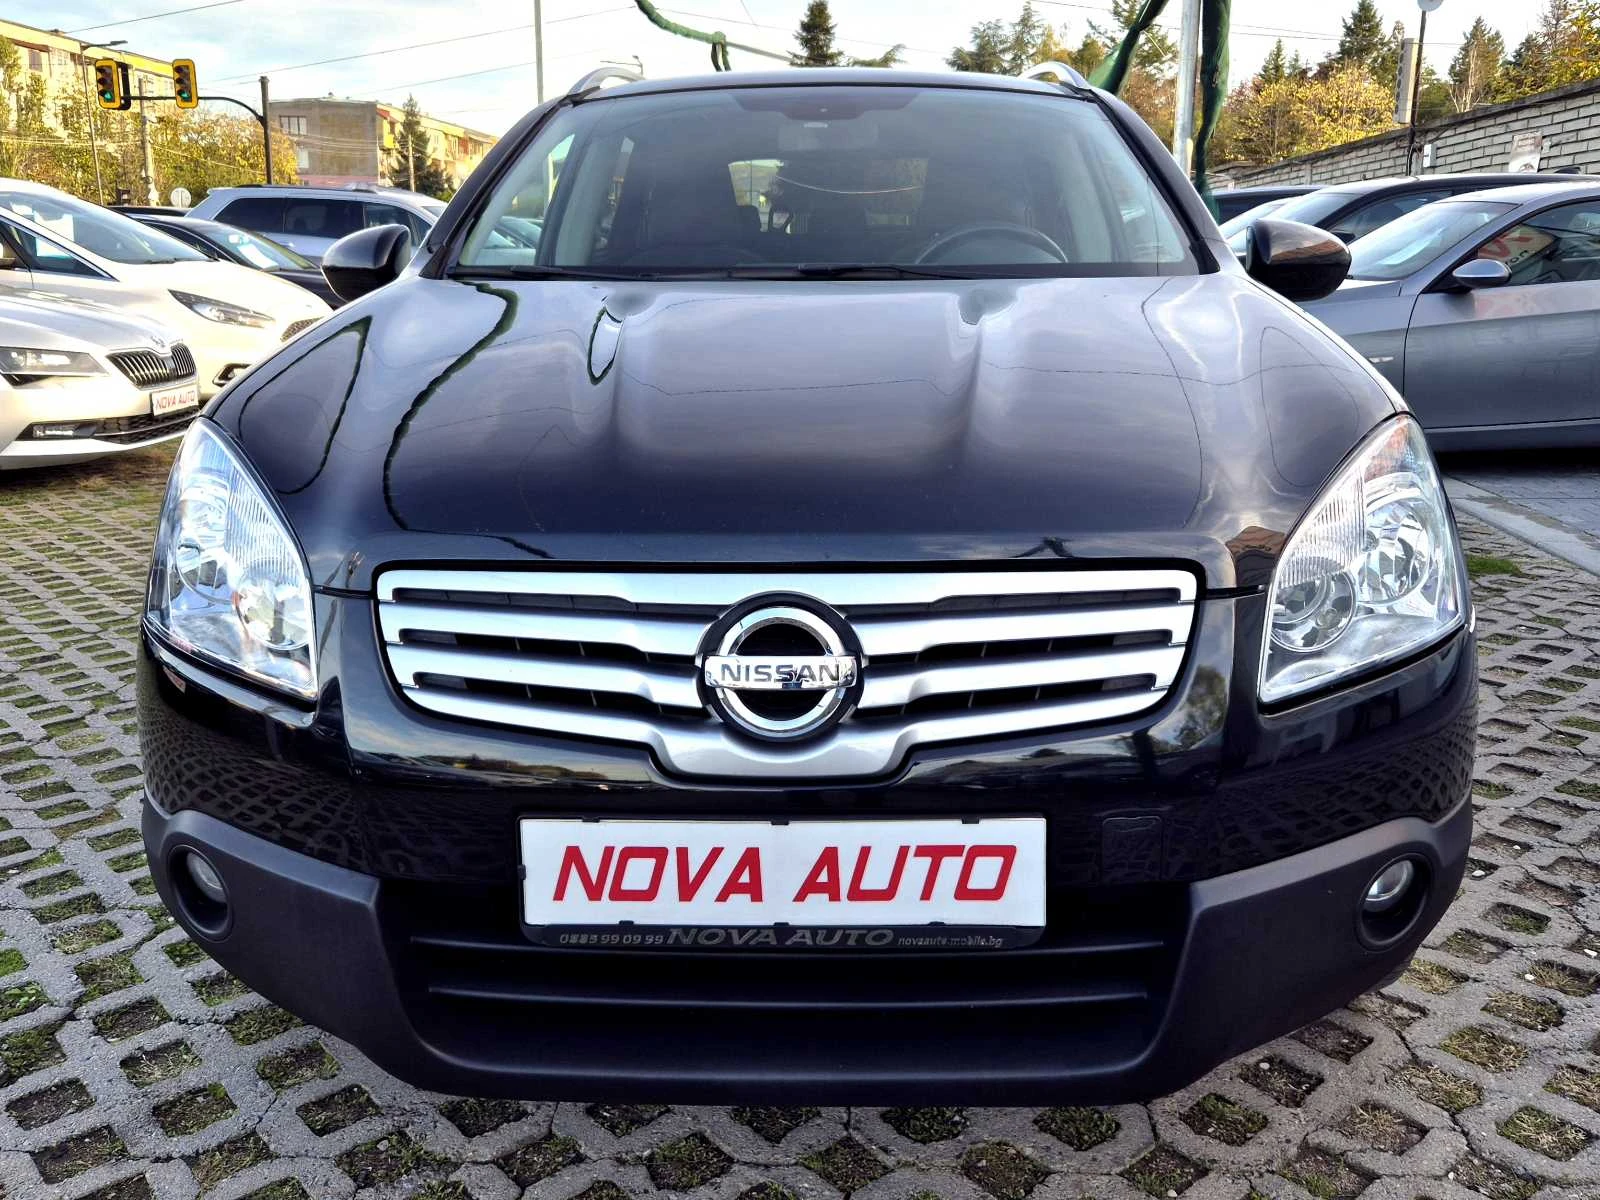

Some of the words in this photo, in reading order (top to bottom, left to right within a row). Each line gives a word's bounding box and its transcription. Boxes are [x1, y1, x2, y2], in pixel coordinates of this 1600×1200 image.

[156, 394, 177, 410] NOVA
[178, 390, 195, 404] AUTO
[720, 663, 840, 682] NISSAN
[552, 845, 763, 902] NOVA
[793, 844, 1018, 902] AUTO
[666, 928, 778, 945] NOVA
[785, 929, 894, 946] AUTO
